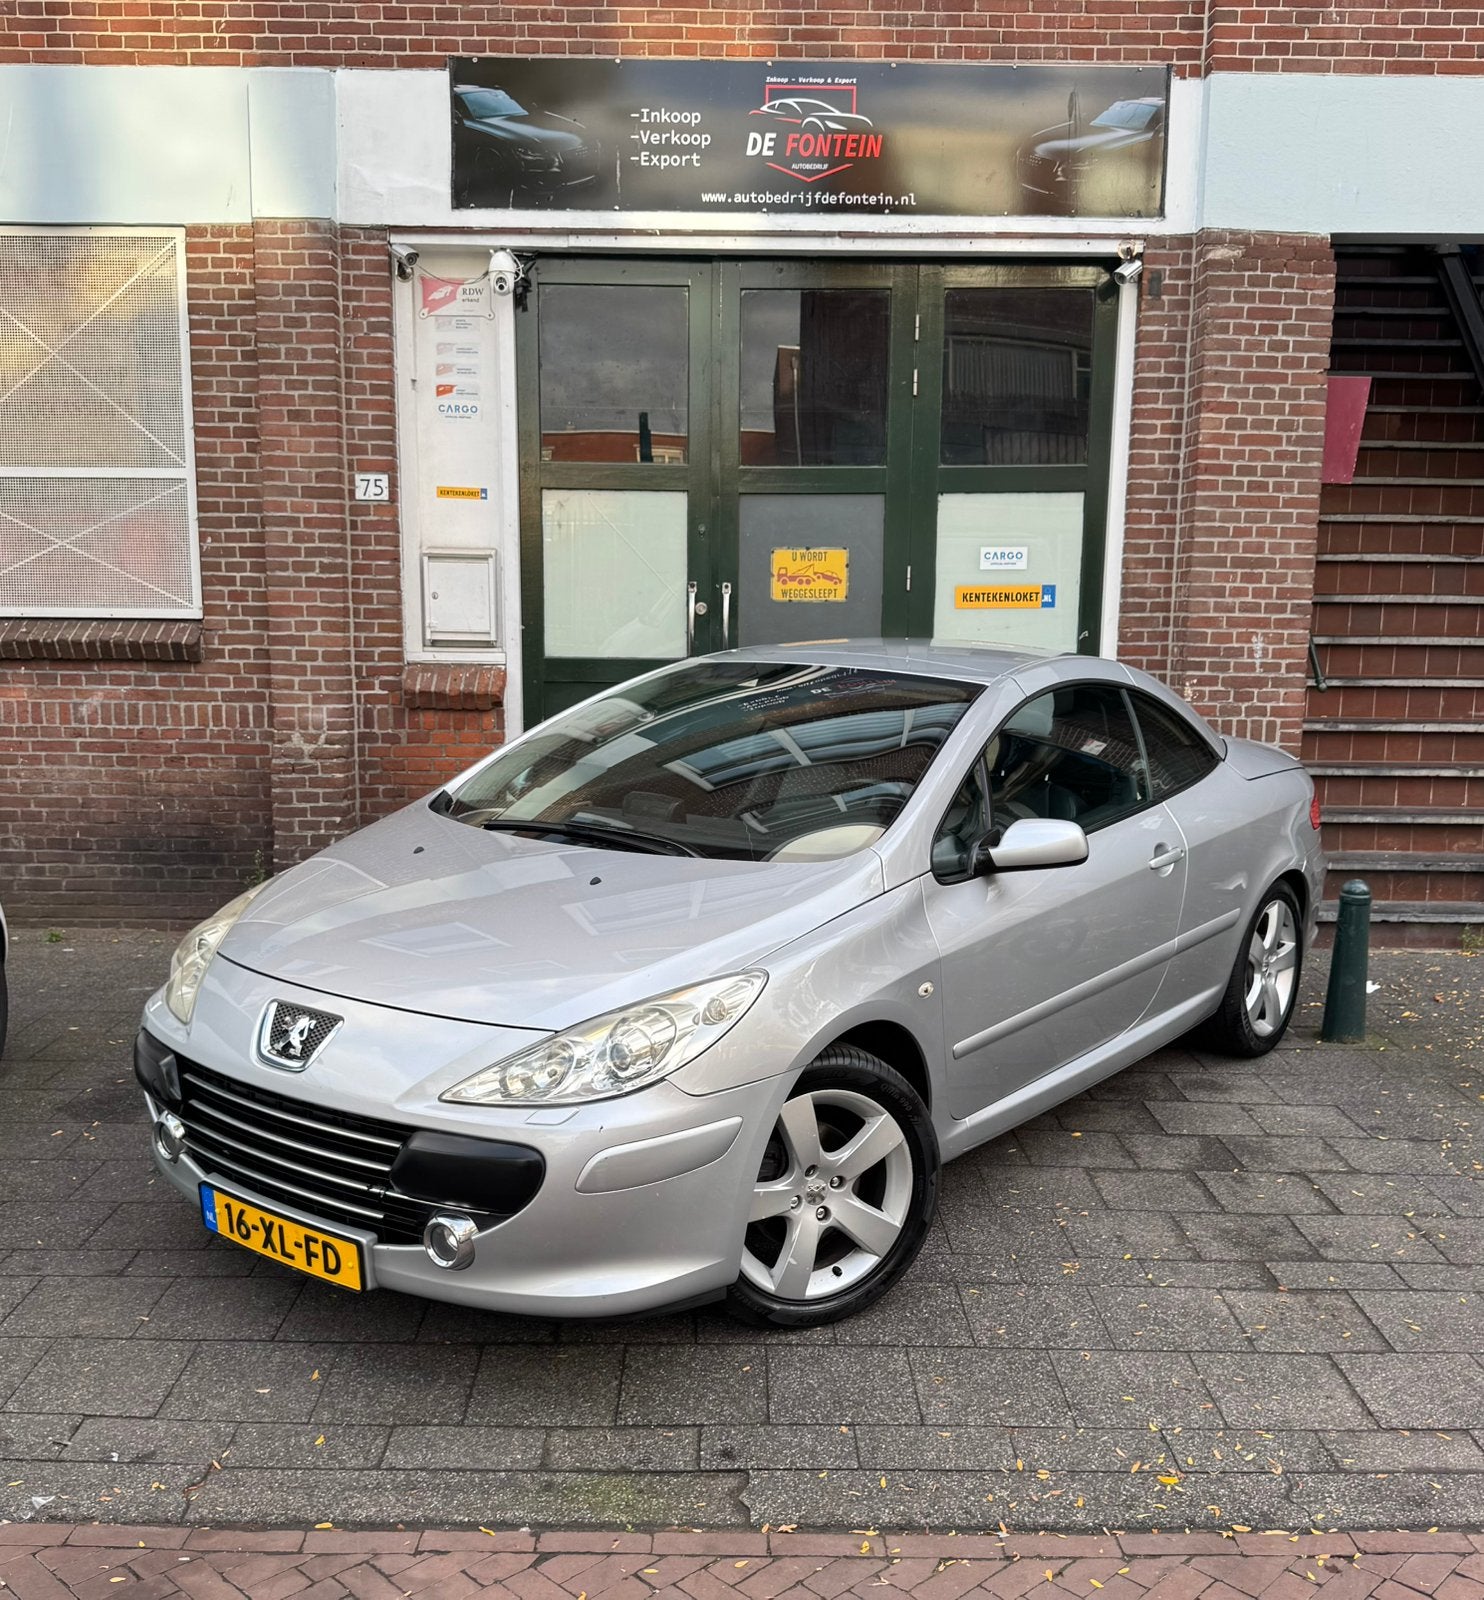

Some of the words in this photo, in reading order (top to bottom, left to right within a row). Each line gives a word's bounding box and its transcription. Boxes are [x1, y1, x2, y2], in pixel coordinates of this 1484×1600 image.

[745, 132, 777, 157] DE
[785, 133, 883, 158] FONTEIN
[701, 191, 917, 206] www.autobedrijfdefontein.nl
[462, 287, 484, 296] RDW
[438, 404, 478, 414] CARGO
[359, 478, 384, 496] 75
[791, 551, 798, 562] U
[800, 551, 828, 562] WORDT
[984, 551, 1024, 560] CARGO
[781, 588, 838, 599] WEGGESLEEPT
[206, 1210, 217, 1224] NL
[224, 1202, 342, 1276] 16-XL-FD
